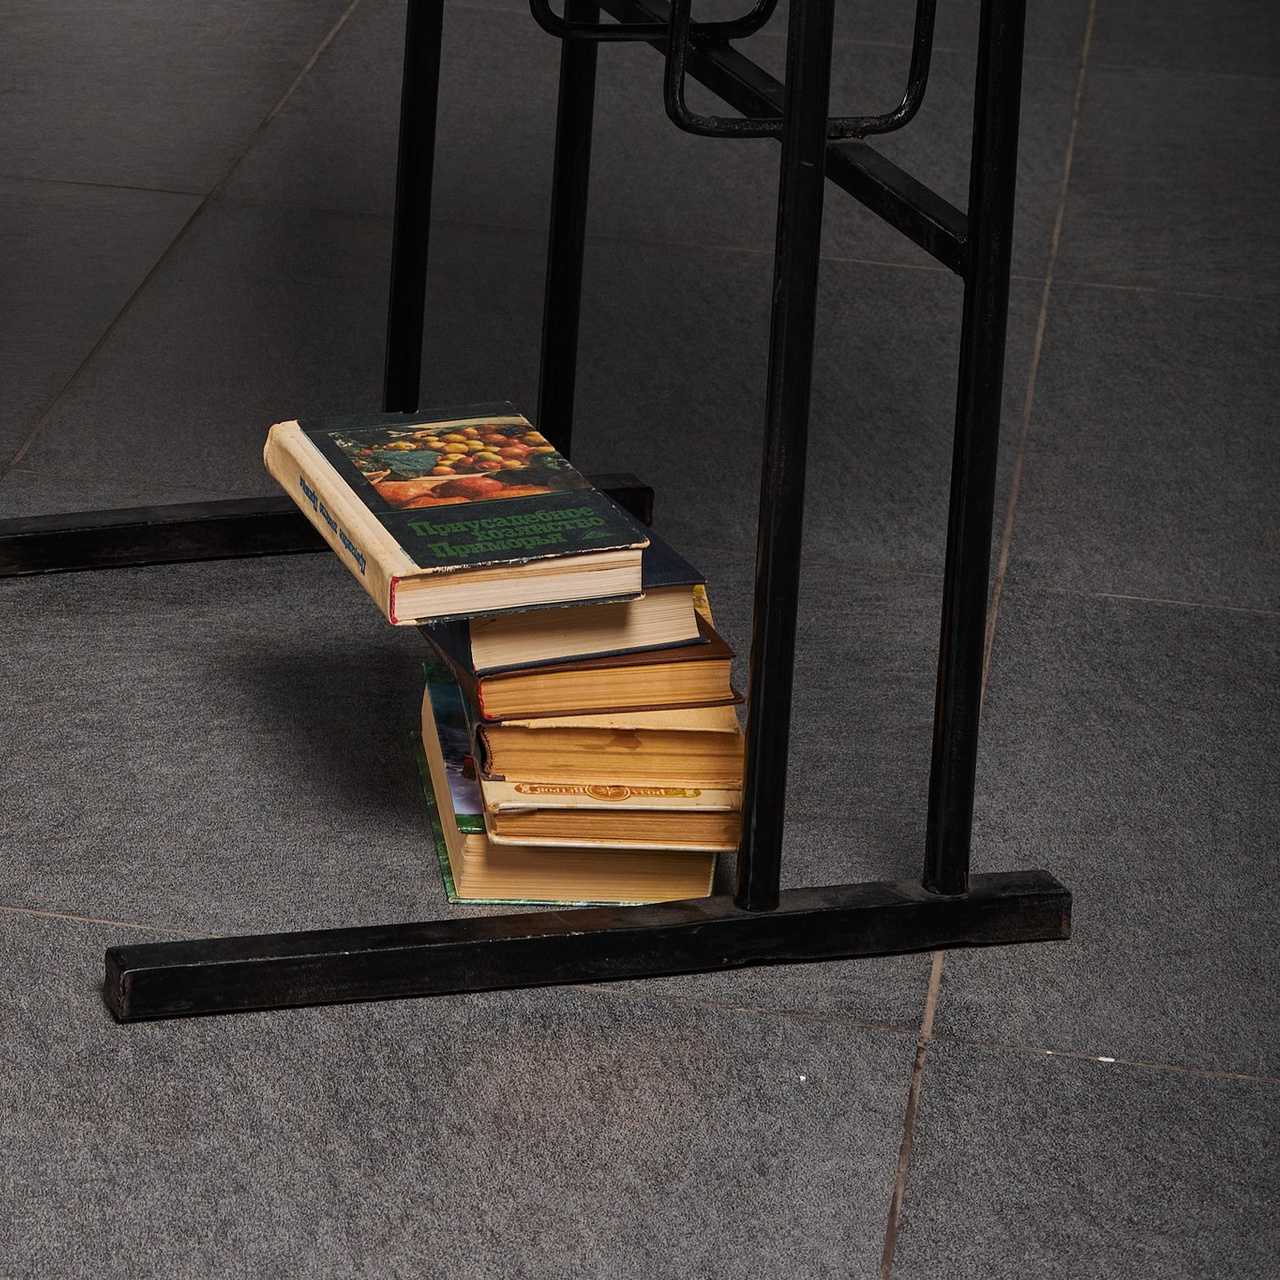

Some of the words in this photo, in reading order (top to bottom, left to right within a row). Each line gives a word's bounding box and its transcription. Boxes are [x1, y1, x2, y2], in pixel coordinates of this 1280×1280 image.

[407, 506, 597, 537] Приусадебное
[472, 517, 607, 541] хозяйство
[427, 531, 569, 559] Приморья
